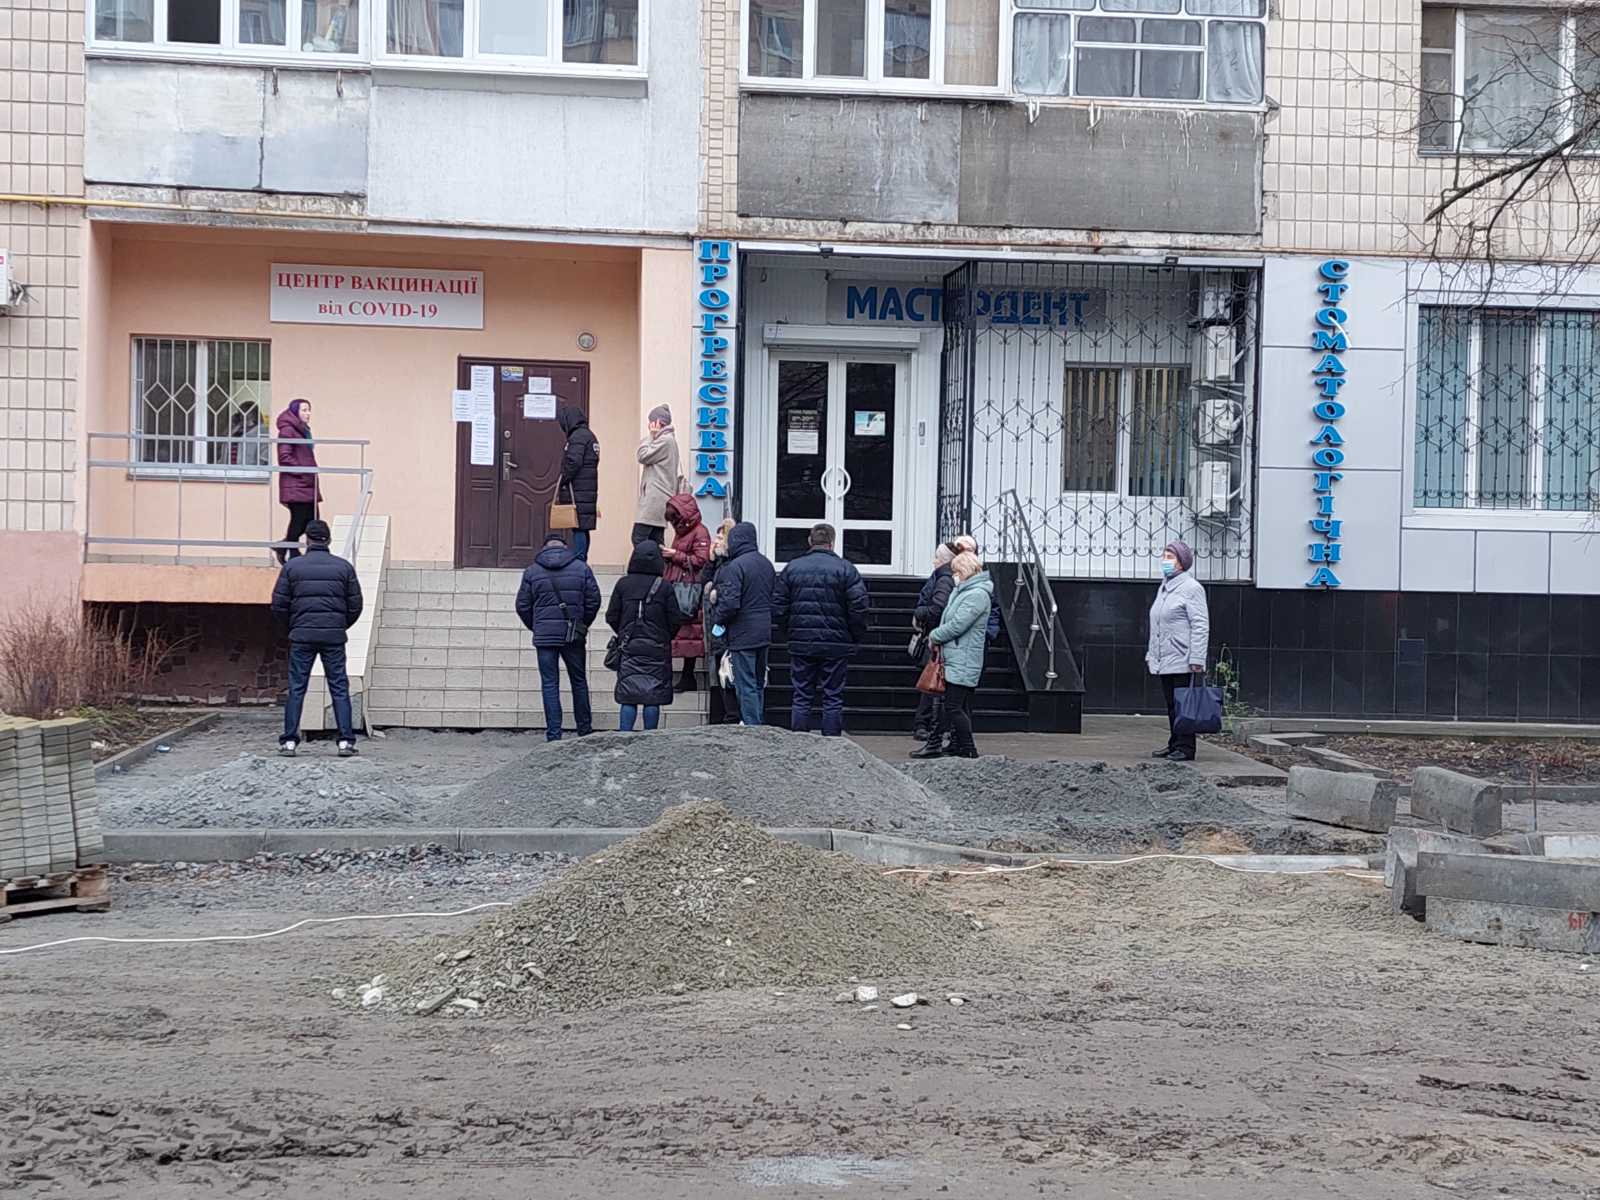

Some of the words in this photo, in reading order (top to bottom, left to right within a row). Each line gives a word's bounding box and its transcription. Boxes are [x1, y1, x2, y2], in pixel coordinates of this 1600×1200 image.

[277, 272, 345, 290] ЦЕНТР
[351, 275, 478, 297] ВАКЦИНАЦІЇ
[318, 299, 343, 316] від
[348, 301, 438, 318] COVID-19
[695, 239, 732, 498] ПРОГРЕСИВНА
[1306, 259, 1350, 589] СТОМАТОЛОГІЧНА
